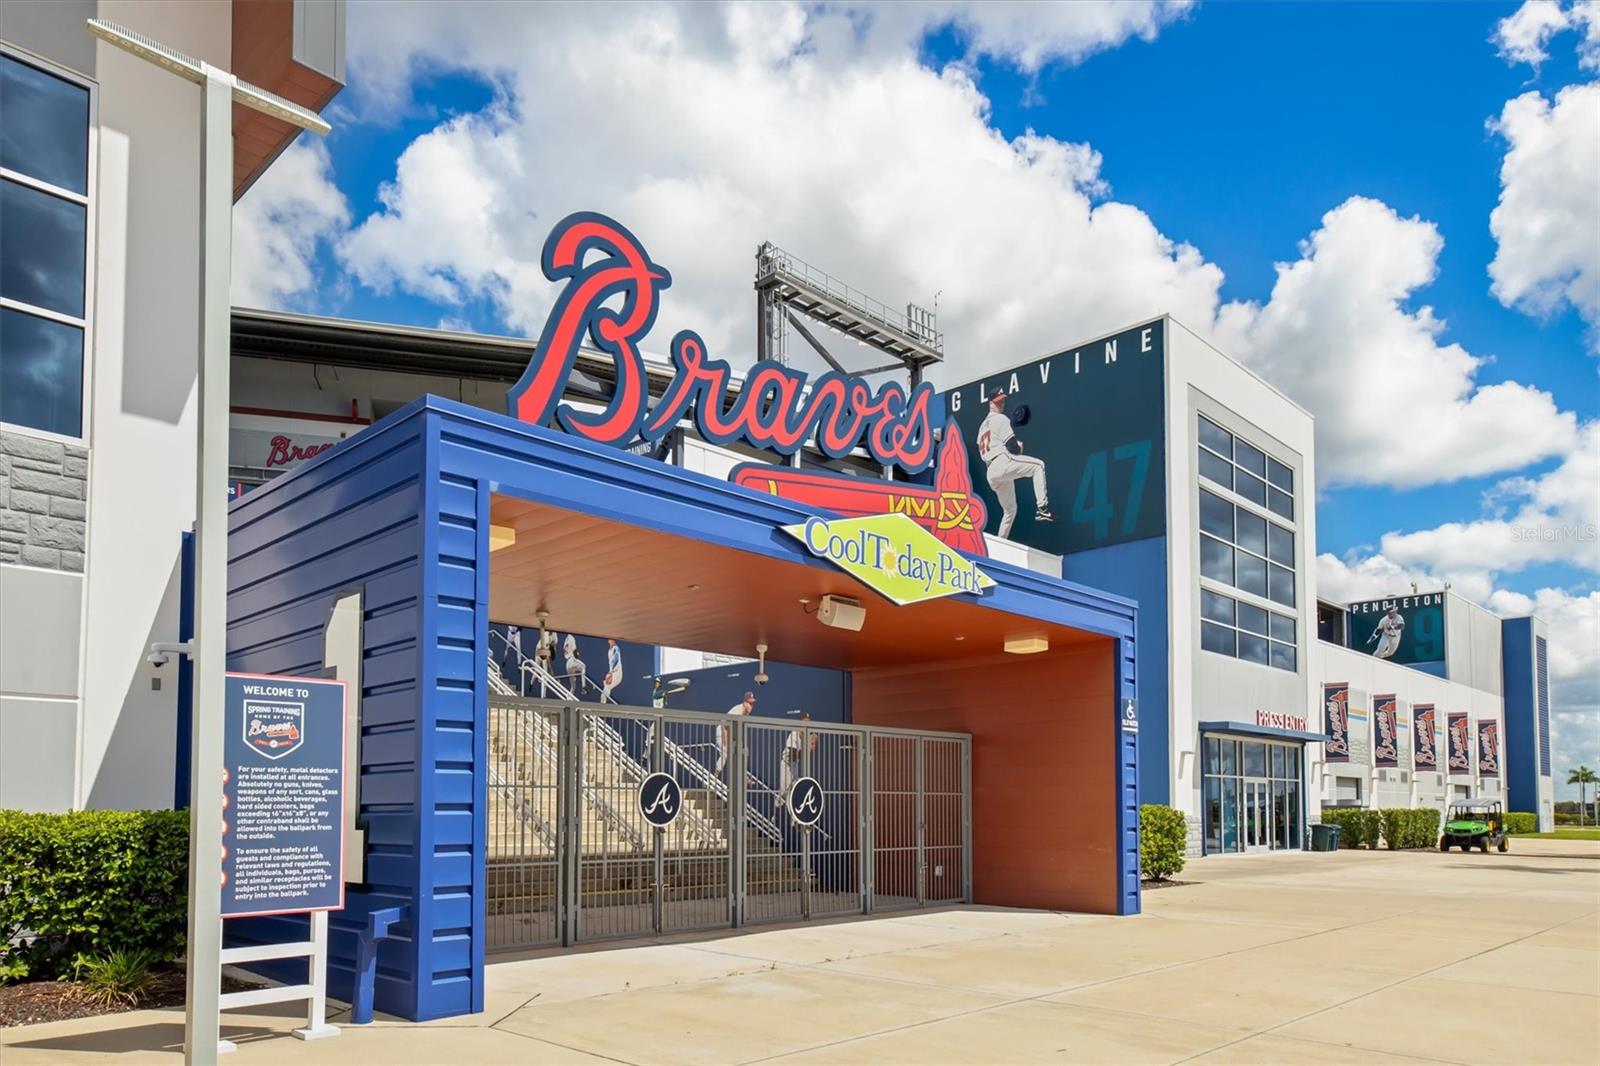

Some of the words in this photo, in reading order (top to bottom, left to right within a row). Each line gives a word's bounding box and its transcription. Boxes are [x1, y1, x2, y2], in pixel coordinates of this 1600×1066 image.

[507, 210, 936, 474] Braves
[951, 328, 1152, 411] GLAVINE
[1071, 440, 1152, 540] 47
[1353, 594, 1441, 614] PENDLETON
[1415, 609, 1442, 660] 9
[243, 685, 294, 697] WELCOME
[296, 689, 309, 698] TO
[247, 705, 271, 714] SPRING
[272, 706, 300, 716] TRAINING
[1256, 710, 1284, 728] PRESS
[1284, 714, 1308, 732] ENTRY
[645, 782, 673, 814] A
[795, 785, 817, 814] A
